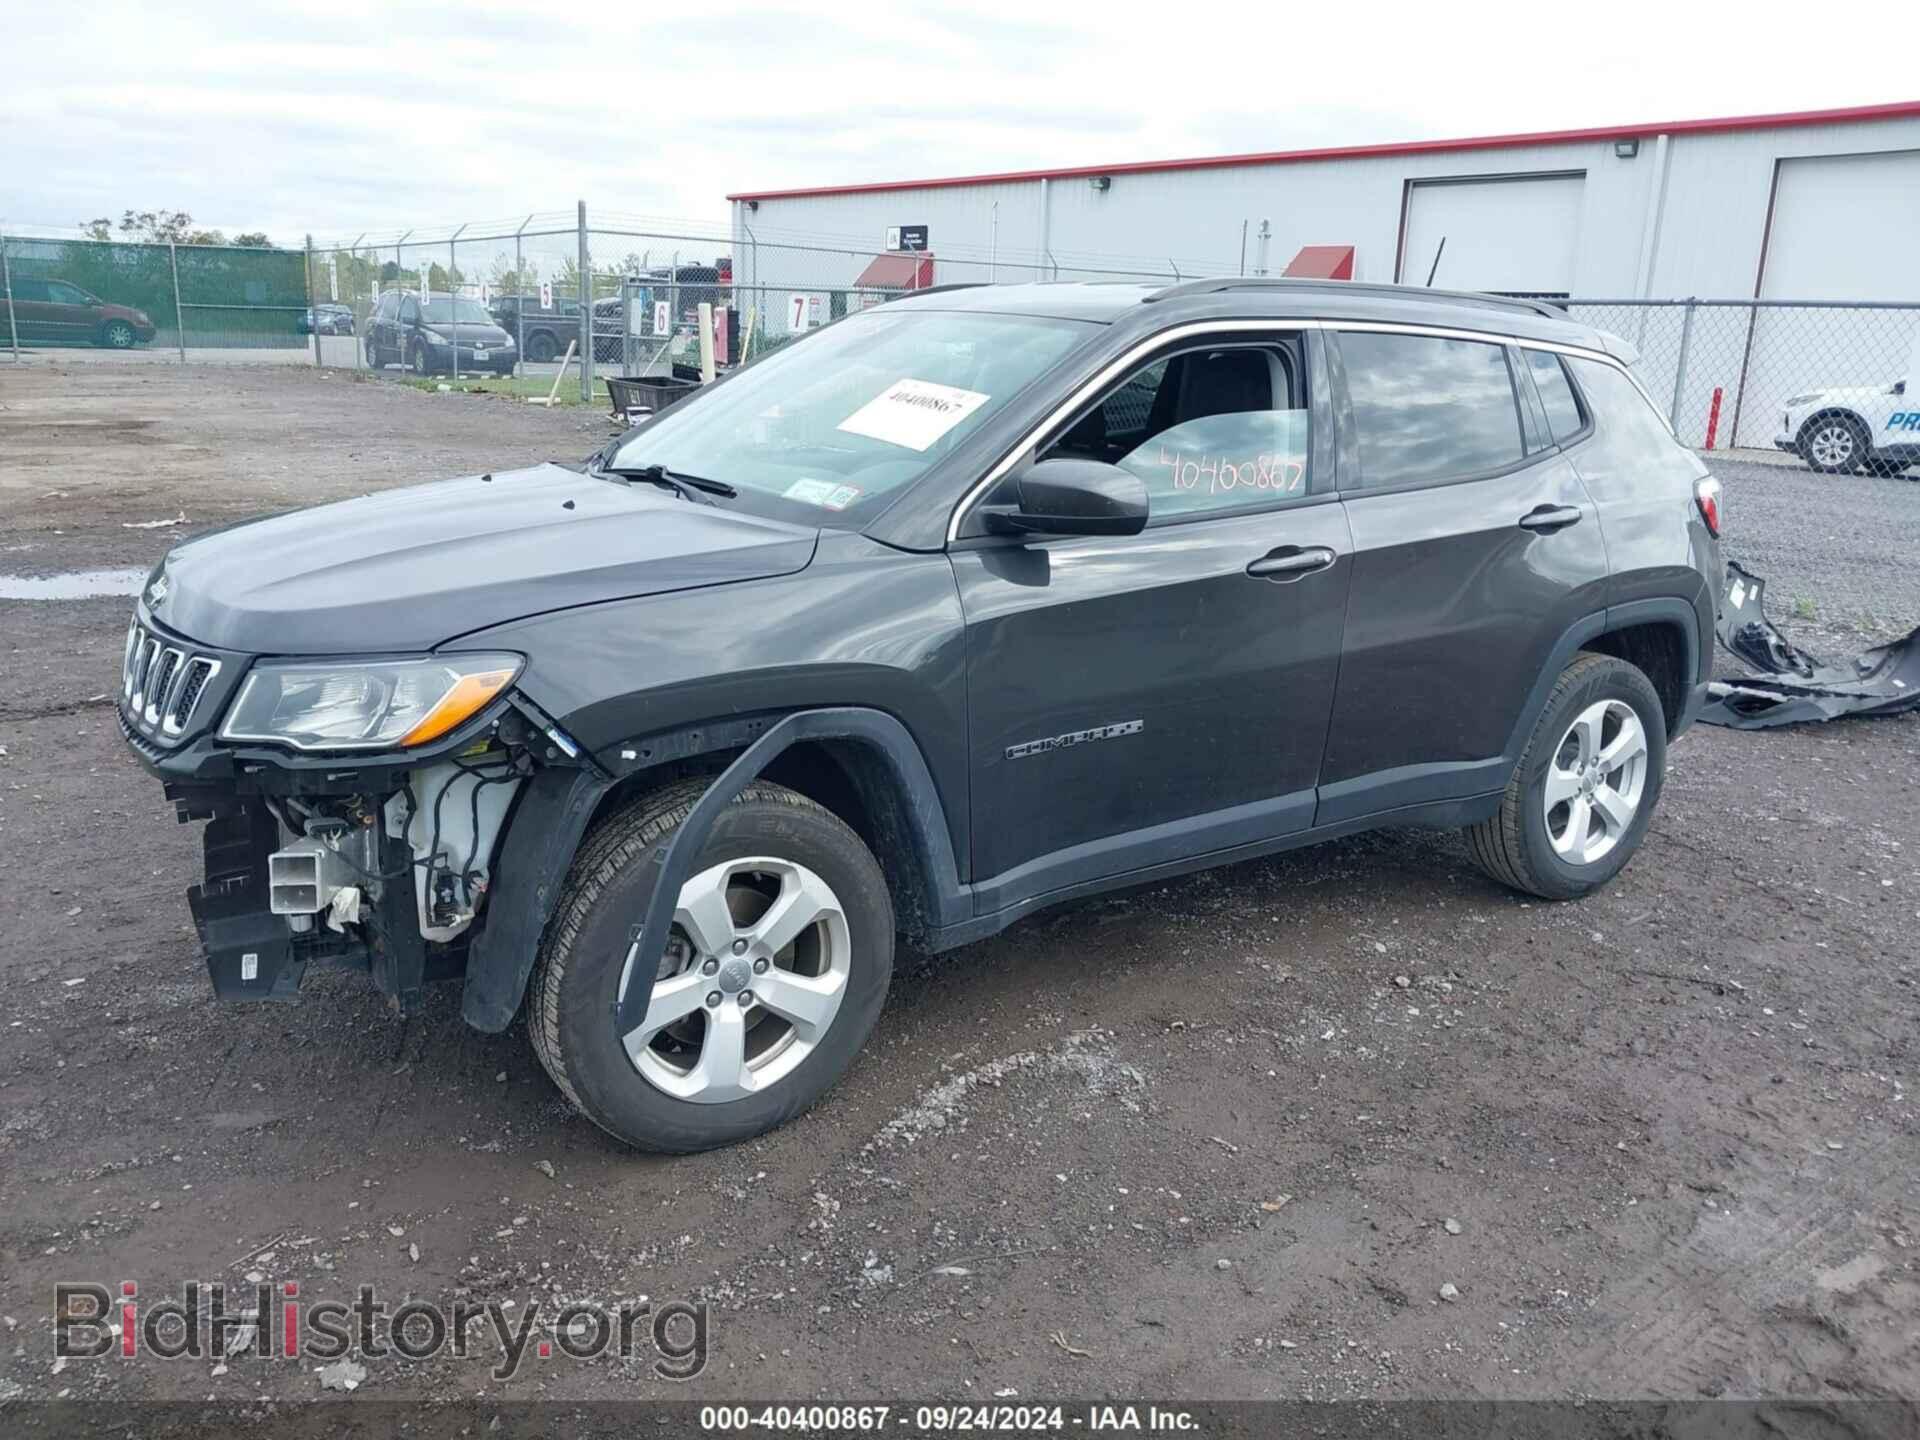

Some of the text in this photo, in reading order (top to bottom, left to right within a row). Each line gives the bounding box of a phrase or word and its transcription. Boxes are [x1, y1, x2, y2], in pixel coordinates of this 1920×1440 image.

[543, 282, 550, 306] 5
[658, 304, 666, 332] 6
[794, 297, 804, 328] 7
[1885, 412, 1920, 431] PR
[1160, 447, 1303, 494] 40400867
